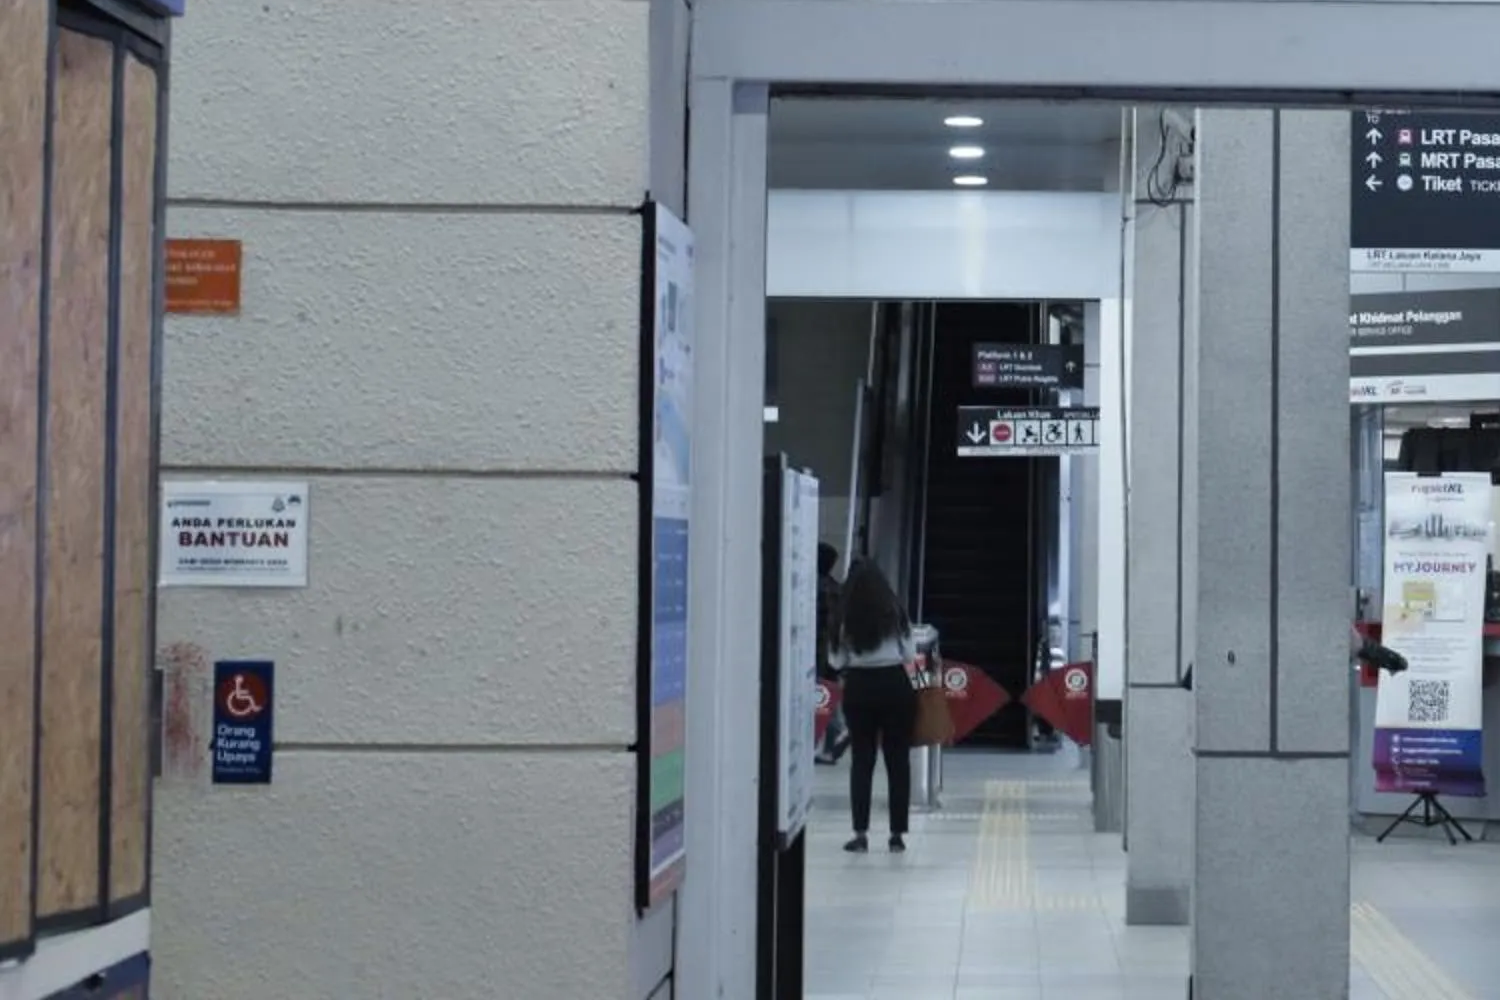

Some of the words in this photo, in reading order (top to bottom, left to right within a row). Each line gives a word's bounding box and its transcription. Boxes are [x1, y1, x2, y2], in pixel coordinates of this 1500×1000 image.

[1420, 129, 1456, 146] LRT
[1420, 152, 1461, 169] MRT
[1422, 174, 1463, 193] Tiket
[172, 517, 212, 528] ANDA
[217, 517, 297, 529] PERLUKAN
[178, 531, 289, 548] BANTUAN
[217, 724, 256, 739] Orang
[217, 737, 261, 752] Kurang
[217, 751, 256, 765] Upaya
